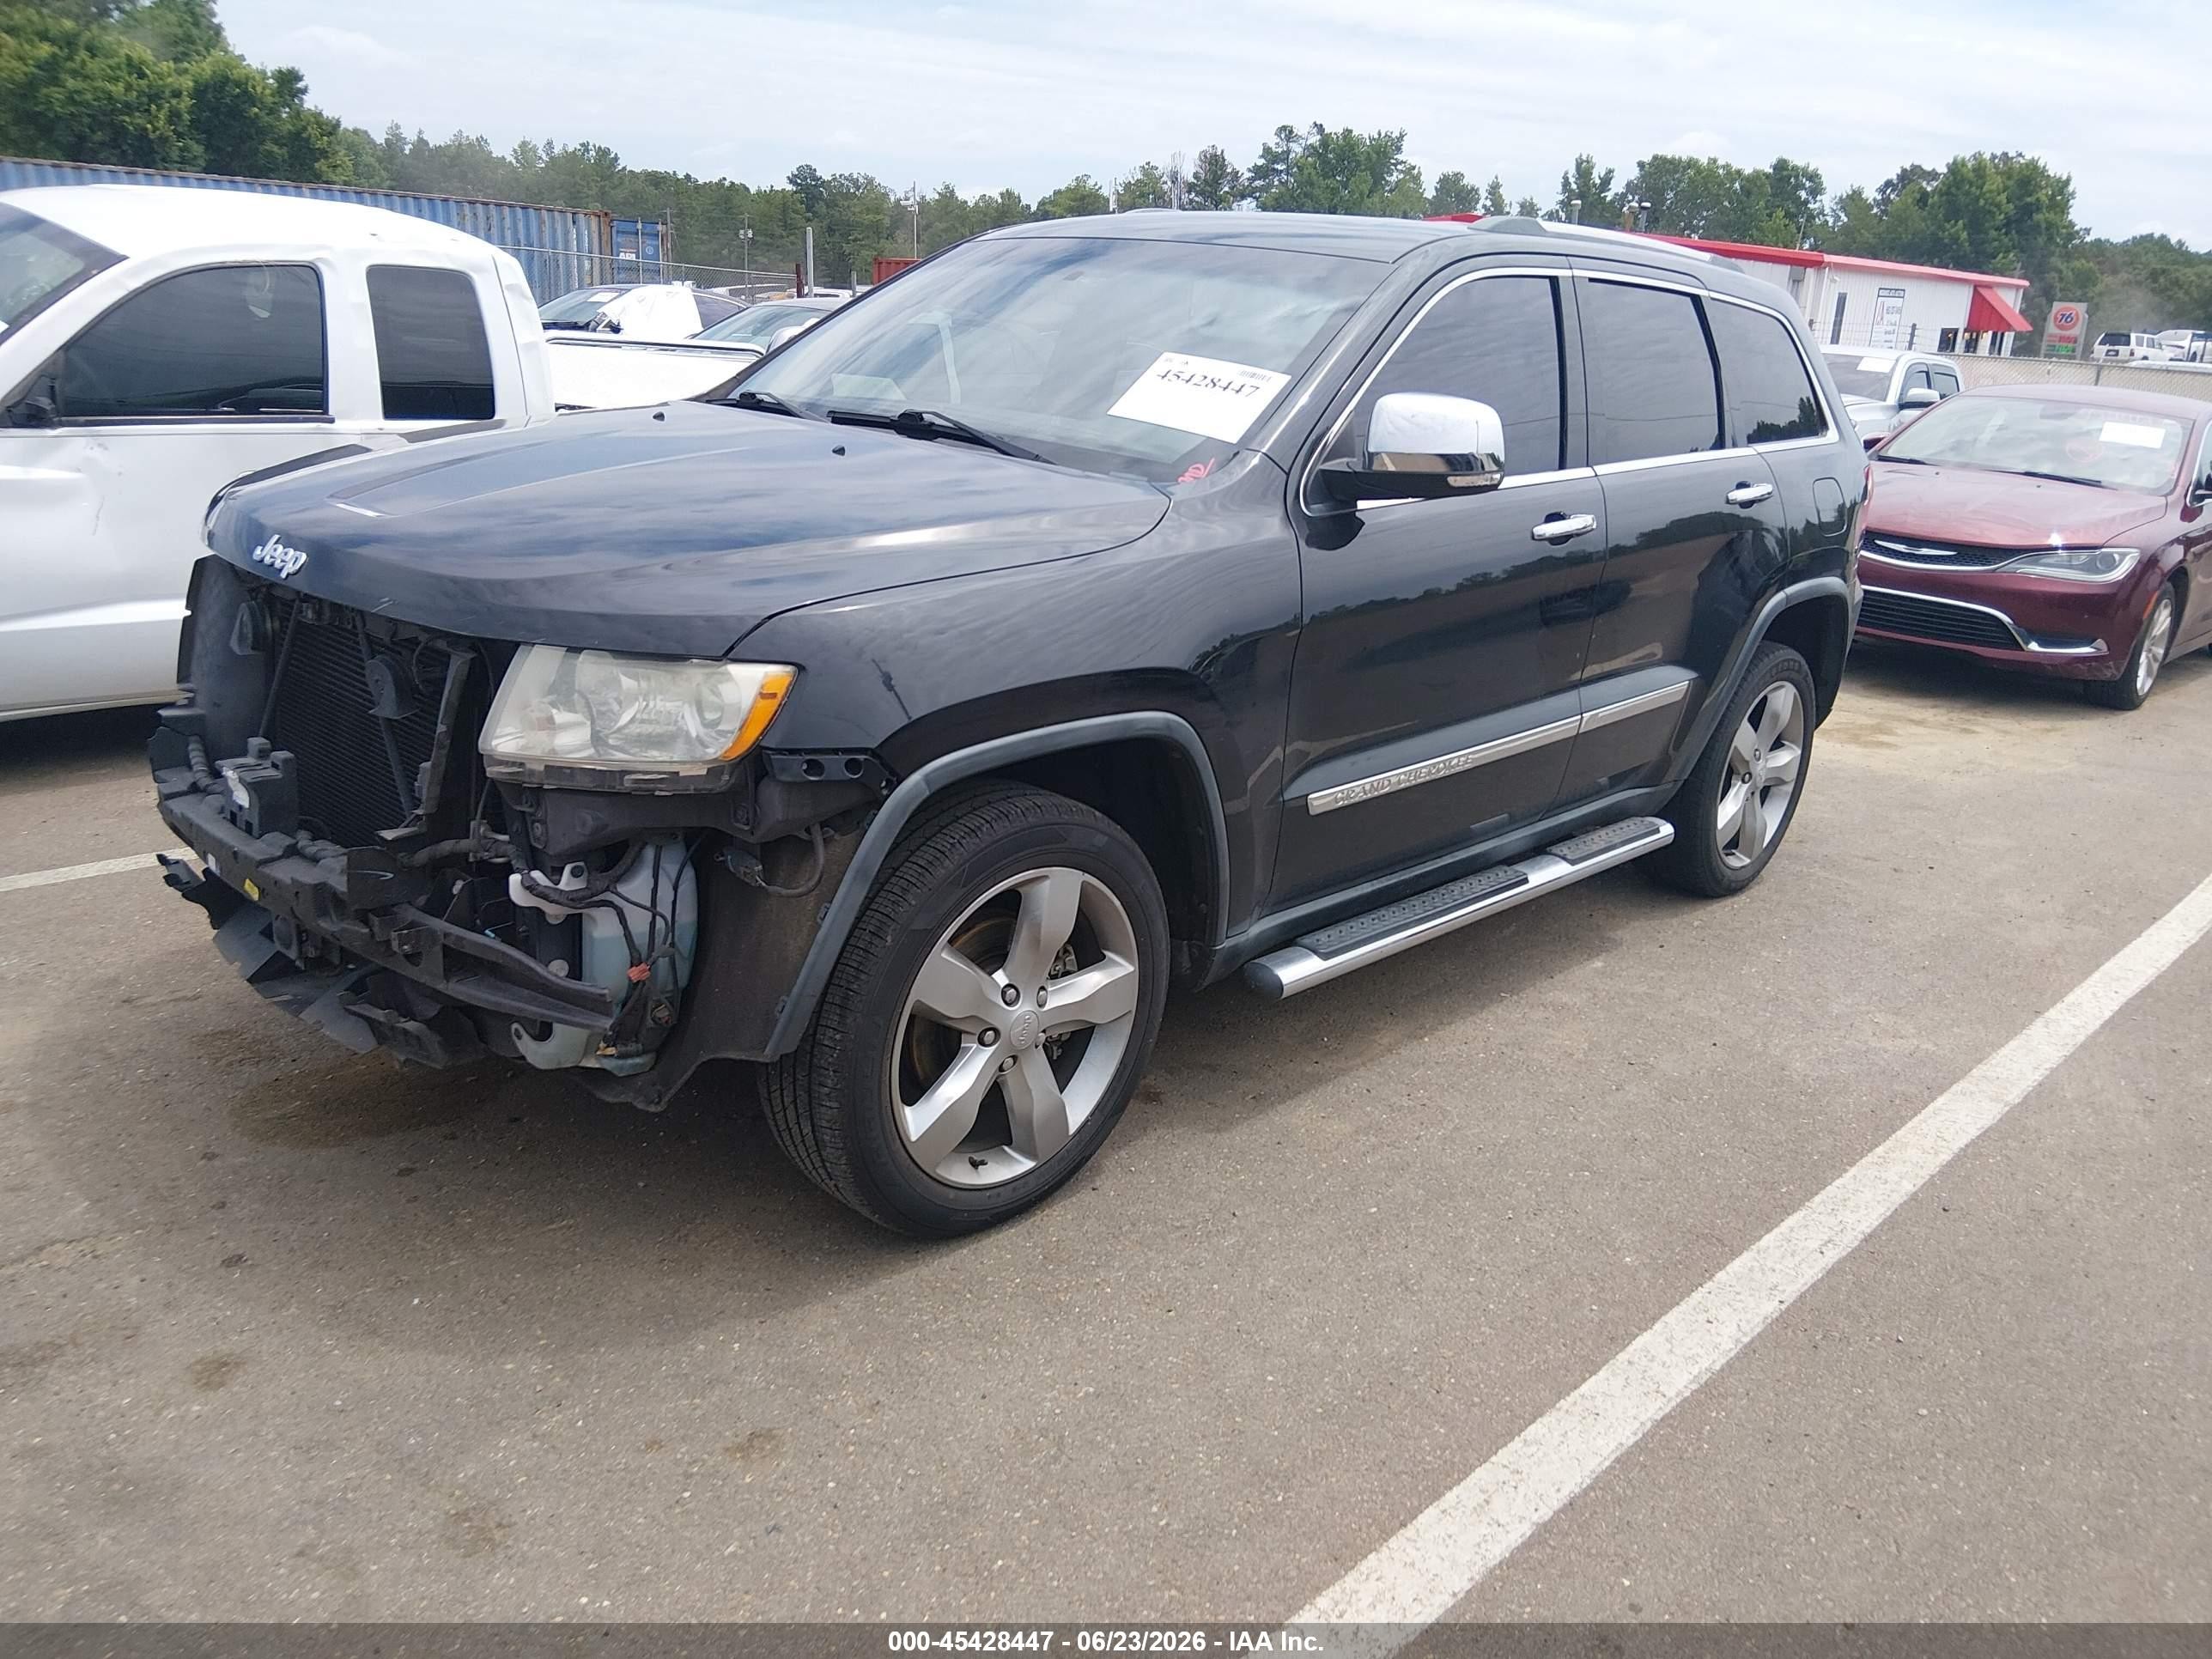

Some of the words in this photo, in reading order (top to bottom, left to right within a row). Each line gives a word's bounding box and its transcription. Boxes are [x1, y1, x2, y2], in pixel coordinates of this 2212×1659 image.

[2057, 312, 2075, 324] 76
[1157, 369, 1260, 397] 45428447
[252, 534, 307, 579] Jeep
[1334, 776, 1392, 806] GRAND
[1395, 754, 1474, 791] CHEROKEE
